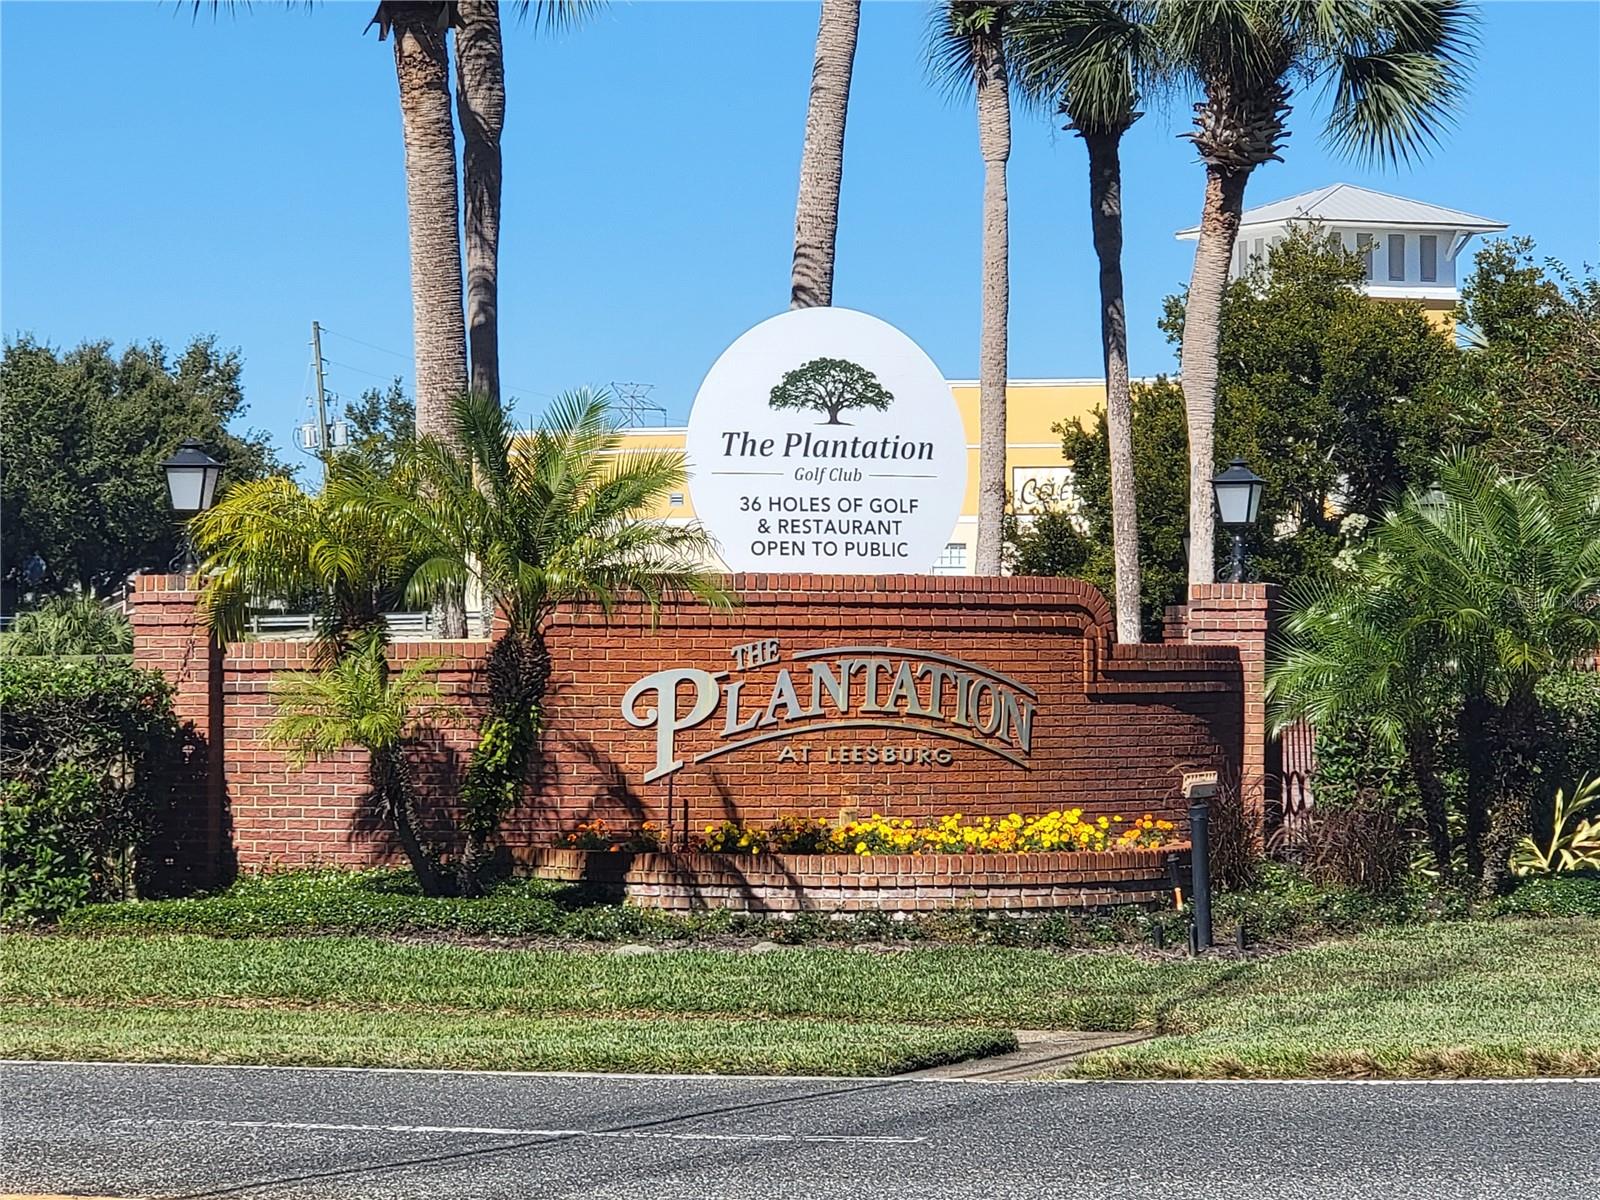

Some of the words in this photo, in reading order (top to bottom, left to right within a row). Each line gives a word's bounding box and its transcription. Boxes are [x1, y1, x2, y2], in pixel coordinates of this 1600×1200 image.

[721, 431, 775, 457] The
[782, 432, 934, 461] Plantation
[794, 467, 827, 485] Golf
[829, 467, 862, 482] Club
[739, 496, 762, 512] 36
[768, 496, 831, 513] HOLES
[837, 497, 863, 513] OF
[869, 497, 919, 514] GOLF
[757, 518, 771, 534] &
[778, 518, 903, 536] RESTAURANT
[750, 540, 805, 556] OPEN
[811, 540, 838, 557] TO
[844, 541, 909, 558] PUBLIC
[731, 638, 781, 671] THE
[621, 658, 1036, 783] PLANTATION
[777, 745, 812, 764] AT
[826, 745, 954, 765] LEESBURG
